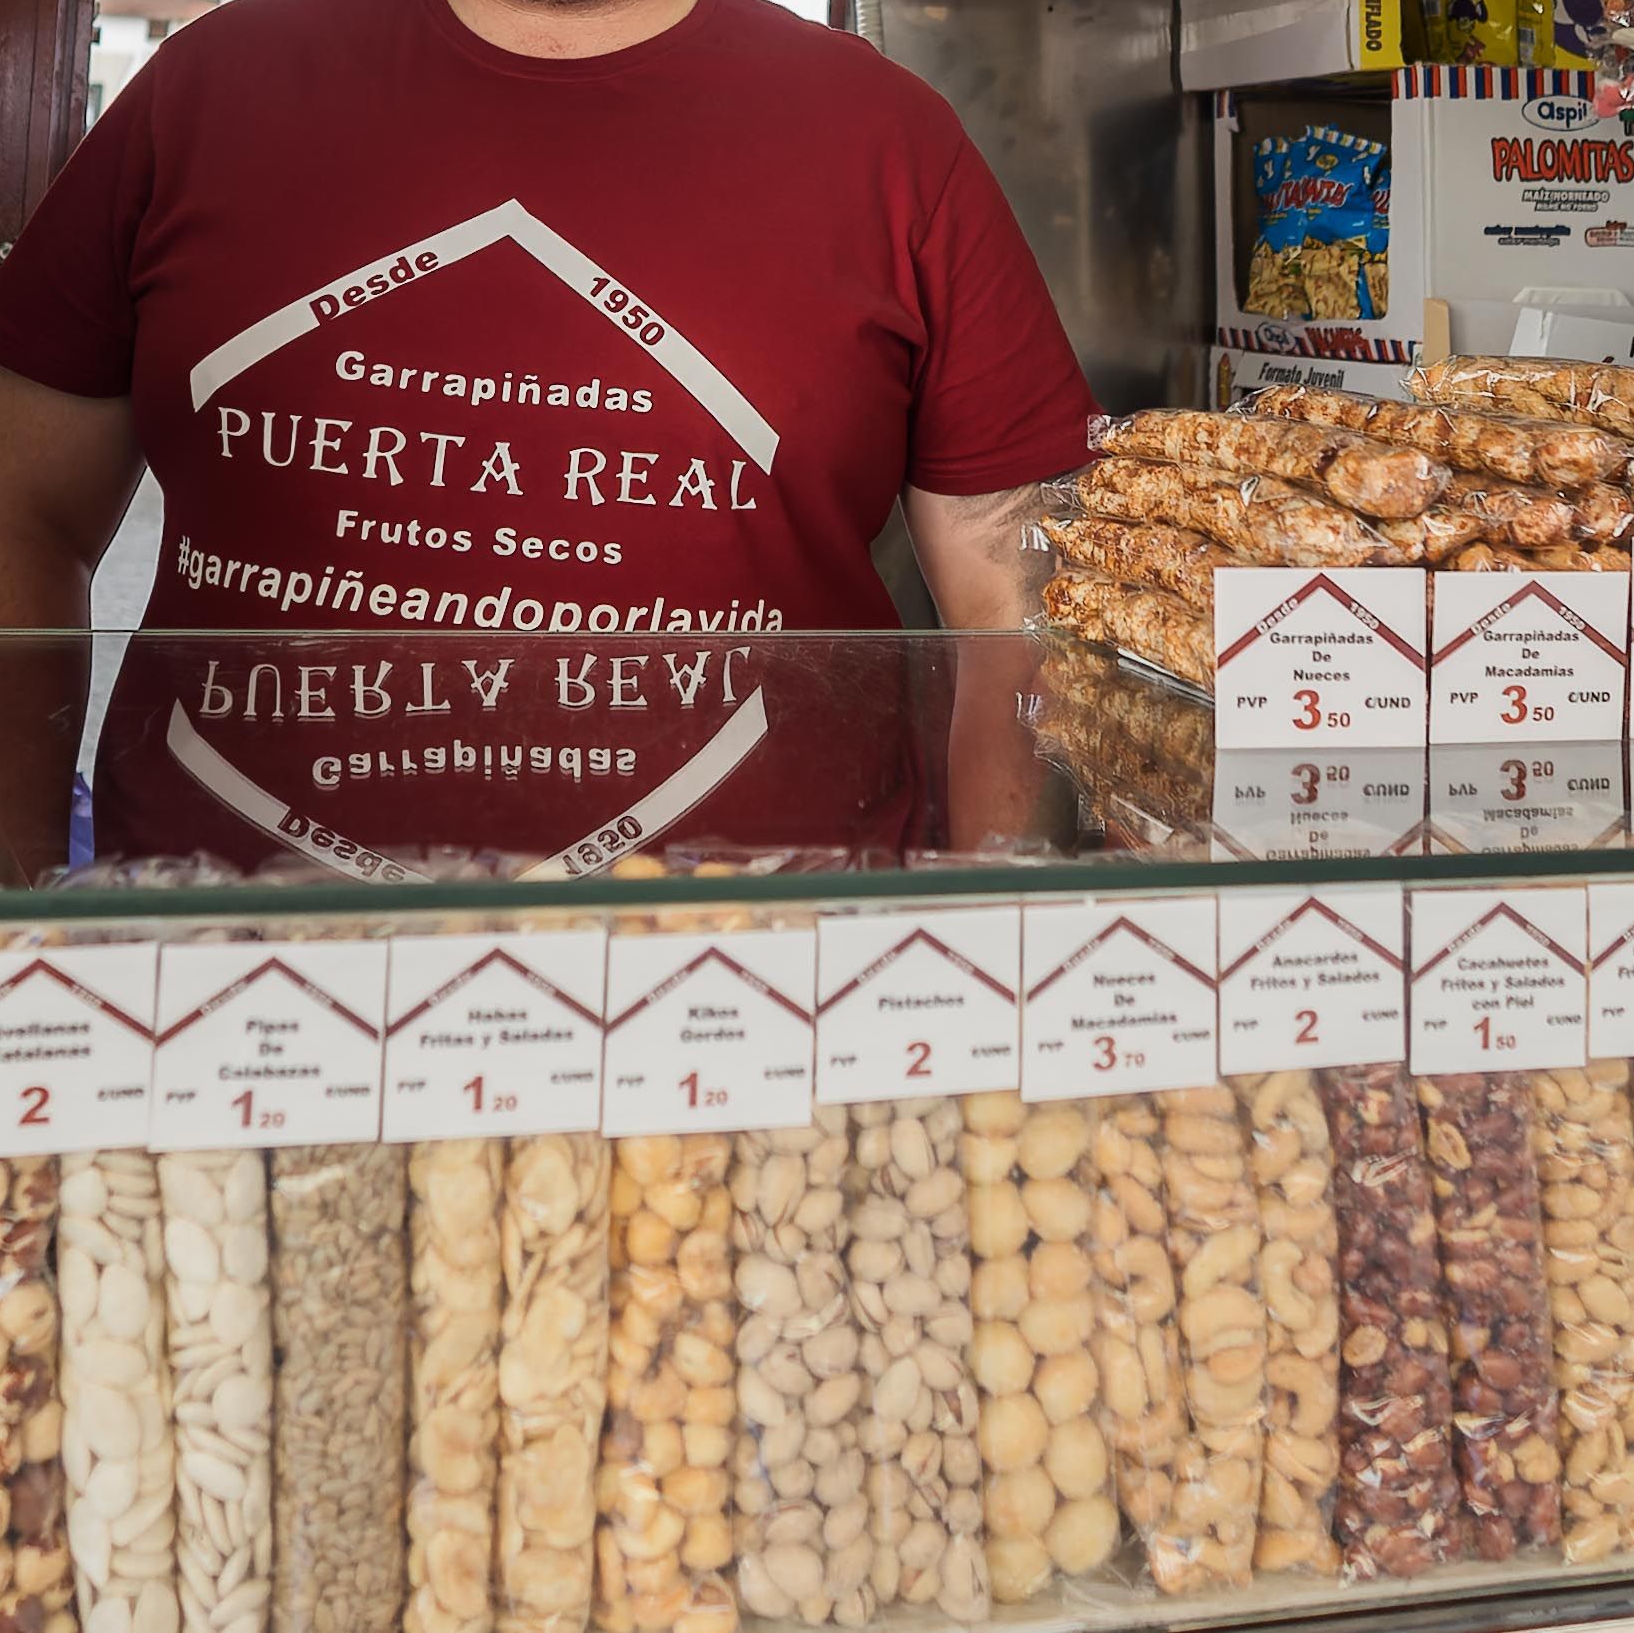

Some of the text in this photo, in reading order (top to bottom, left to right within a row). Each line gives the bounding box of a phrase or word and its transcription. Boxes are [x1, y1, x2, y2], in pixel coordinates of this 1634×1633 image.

[307, 249, 666, 348] Desde 1950
[334, 349, 655, 413] Garrapiñadas
[216, 406, 759, 511] PUERTA REAL
[334, 508, 623, 566] Frutos Secos
[1269, 630, 1374, 646] Garrapiñadas
[1293, 669, 1351, 682] Nueces
[1485, 665, 1574, 678] Macadamias
[1236, 689, 1351, 730] PVP 3 50
[1500, 685, 1554, 724] 3 50
[906, 1042, 933, 1078] 2
[1092, 1036, 1117, 1071] 3
